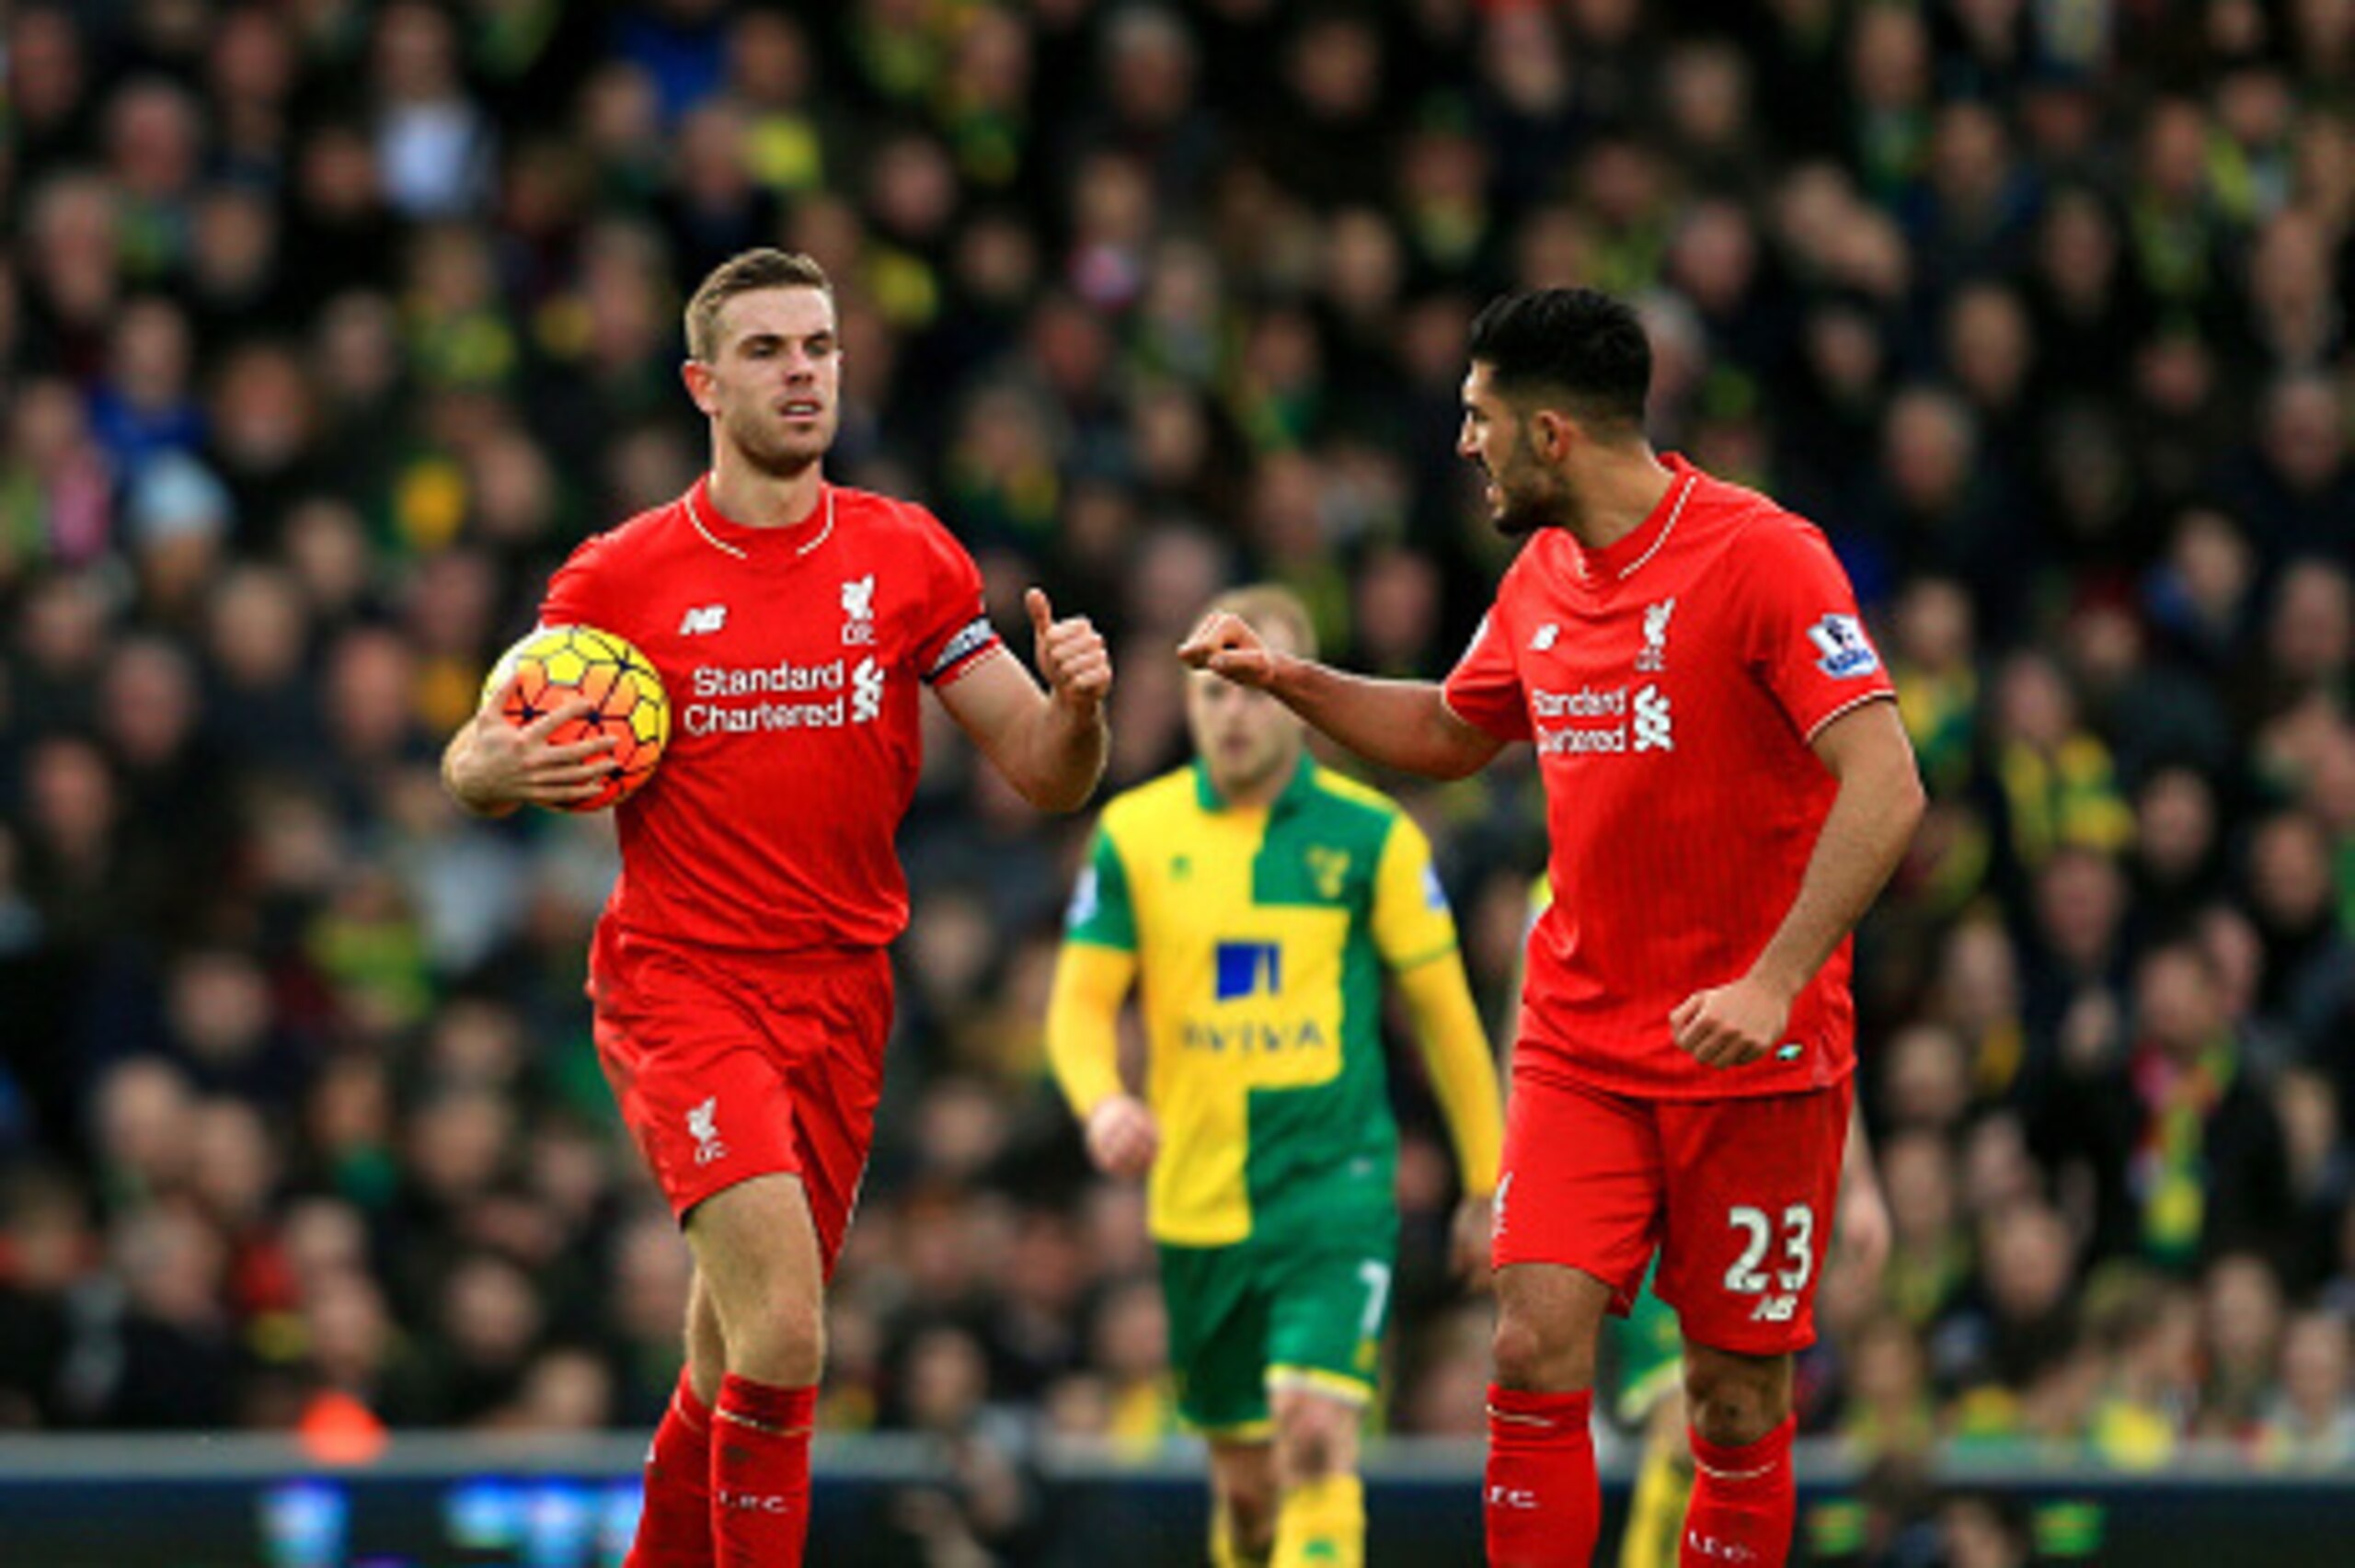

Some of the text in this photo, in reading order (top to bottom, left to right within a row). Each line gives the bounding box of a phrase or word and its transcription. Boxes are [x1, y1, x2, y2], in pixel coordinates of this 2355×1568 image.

[694, 659, 844, 697] Standard
[684, 695, 844, 737] Chartered
[1723, 1203, 1813, 1292] 23
[1361, 1258, 1392, 1338] 7
